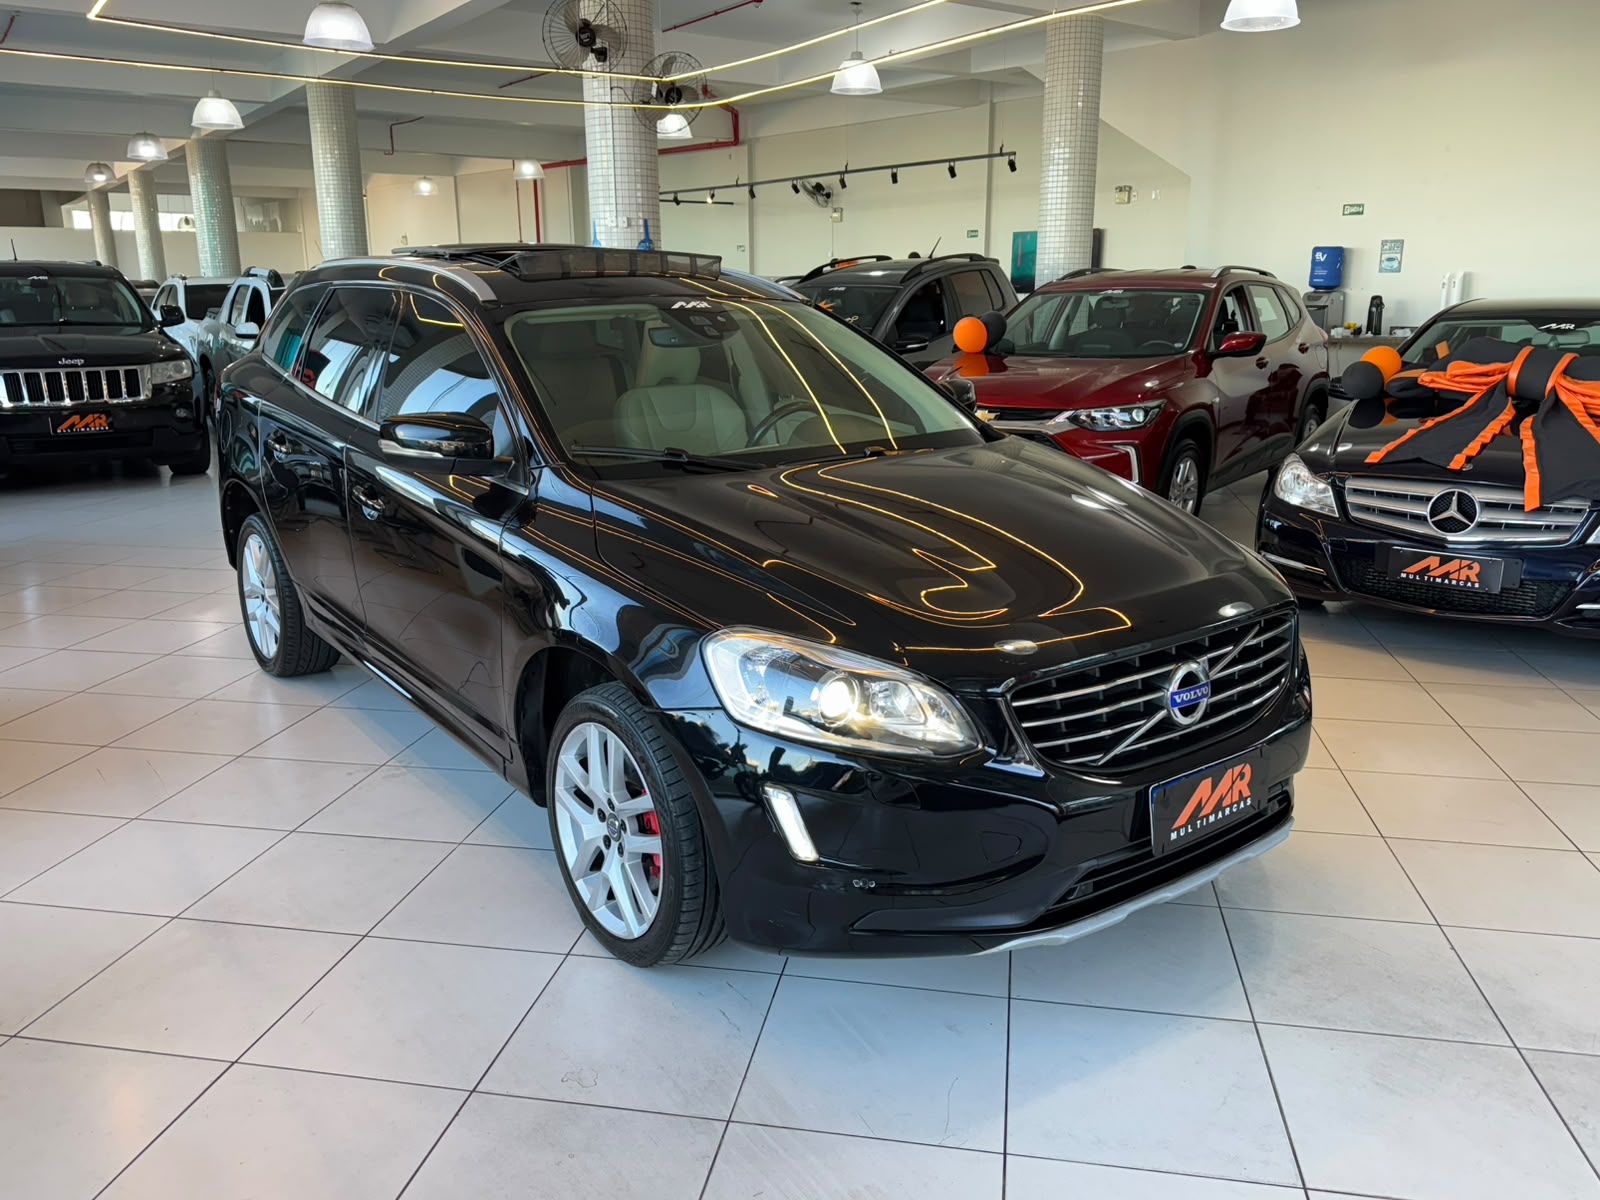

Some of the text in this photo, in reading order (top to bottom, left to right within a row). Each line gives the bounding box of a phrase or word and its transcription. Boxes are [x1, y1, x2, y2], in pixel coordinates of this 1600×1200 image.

[58, 358, 85, 366] Jeep
[1400, 572, 1480, 588] MULTIMARCAS
[1173, 685, 1209, 703] VOLVO
[1170, 797, 1252, 841] MULTIMARCAS
